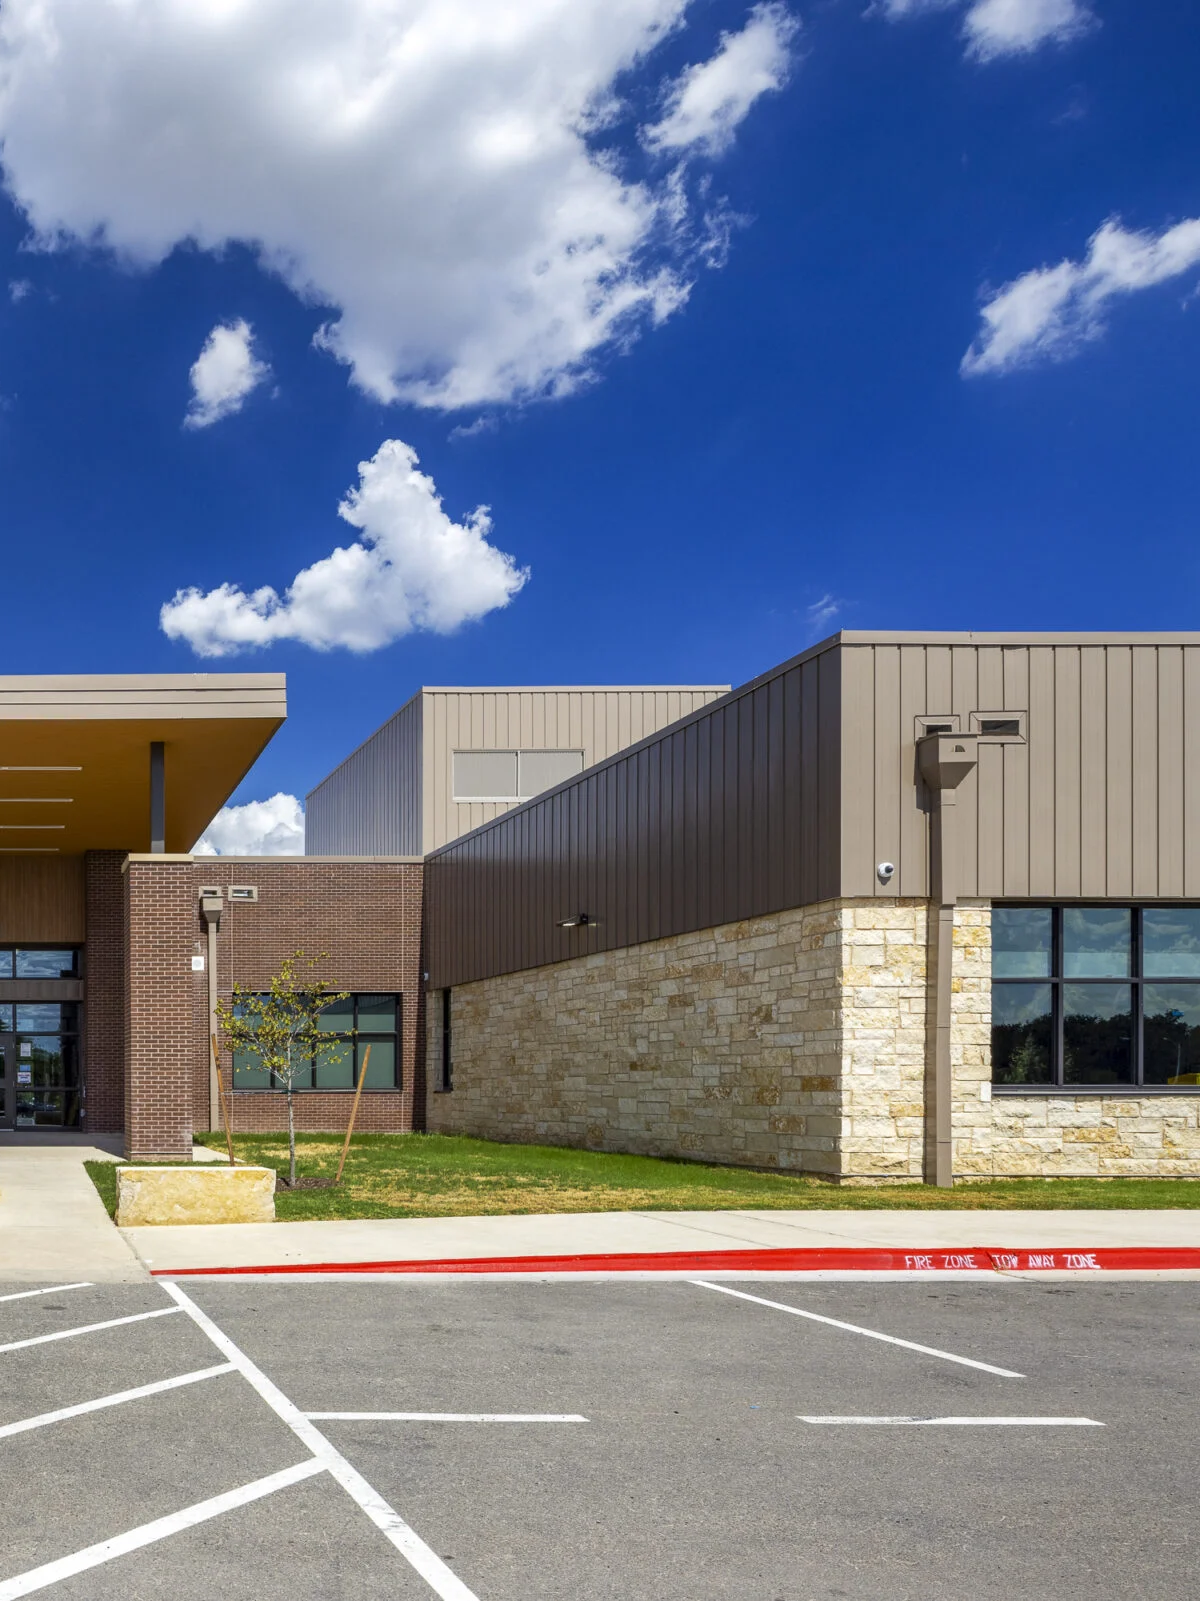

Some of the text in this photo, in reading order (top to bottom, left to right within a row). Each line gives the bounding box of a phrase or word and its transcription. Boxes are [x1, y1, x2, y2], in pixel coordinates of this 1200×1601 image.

[904, 1253, 1101, 1270] FIRE ZONE TOW AWAY ZONE
